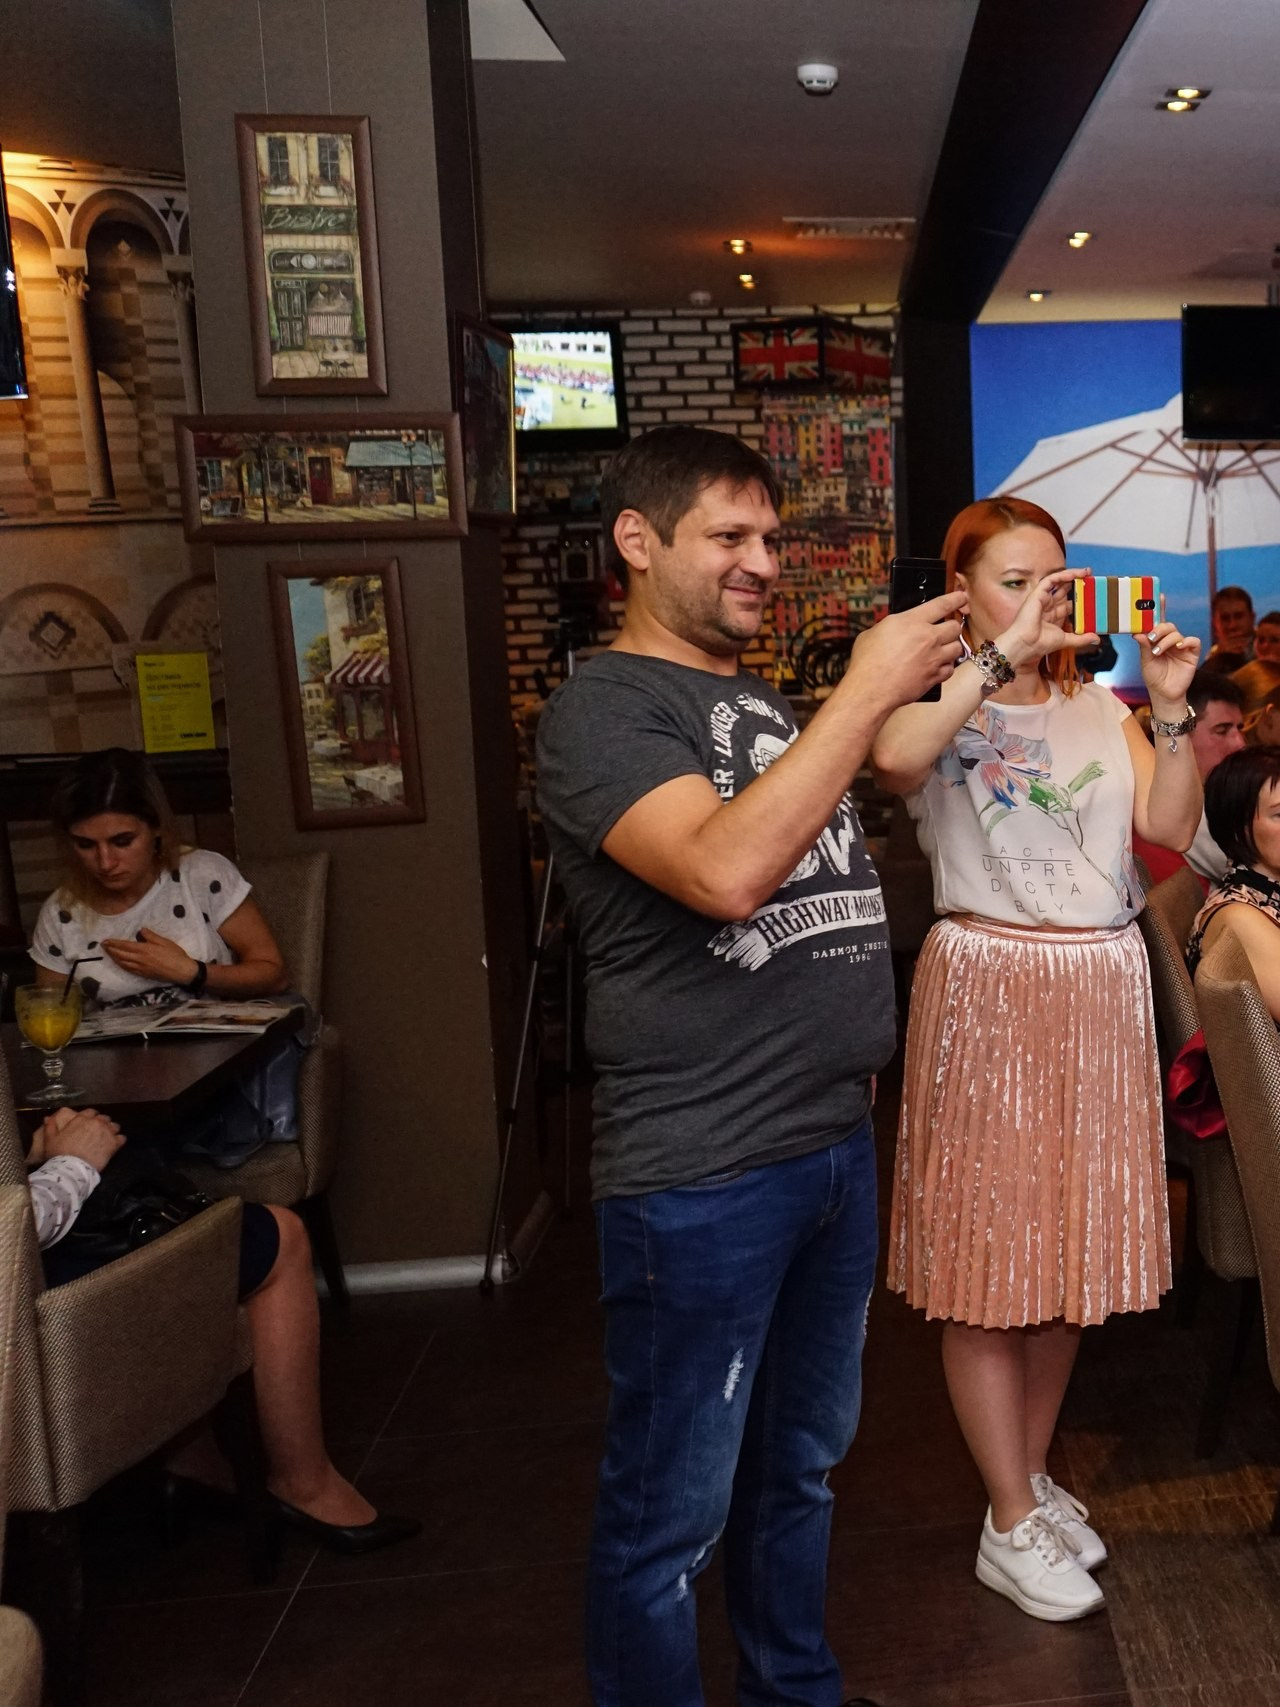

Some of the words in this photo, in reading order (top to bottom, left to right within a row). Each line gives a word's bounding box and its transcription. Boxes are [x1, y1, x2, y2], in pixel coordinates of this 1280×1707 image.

[999, 845, 1055, 857] ACT
[982, 858, 1076, 877] UNPRE
[990, 878, 1082, 897] DICTA
[1013, 899, 1064, 915] BLY
[750, 896, 852, 947] HIGHWAY
[811, 944, 858, 960] DAEMON
